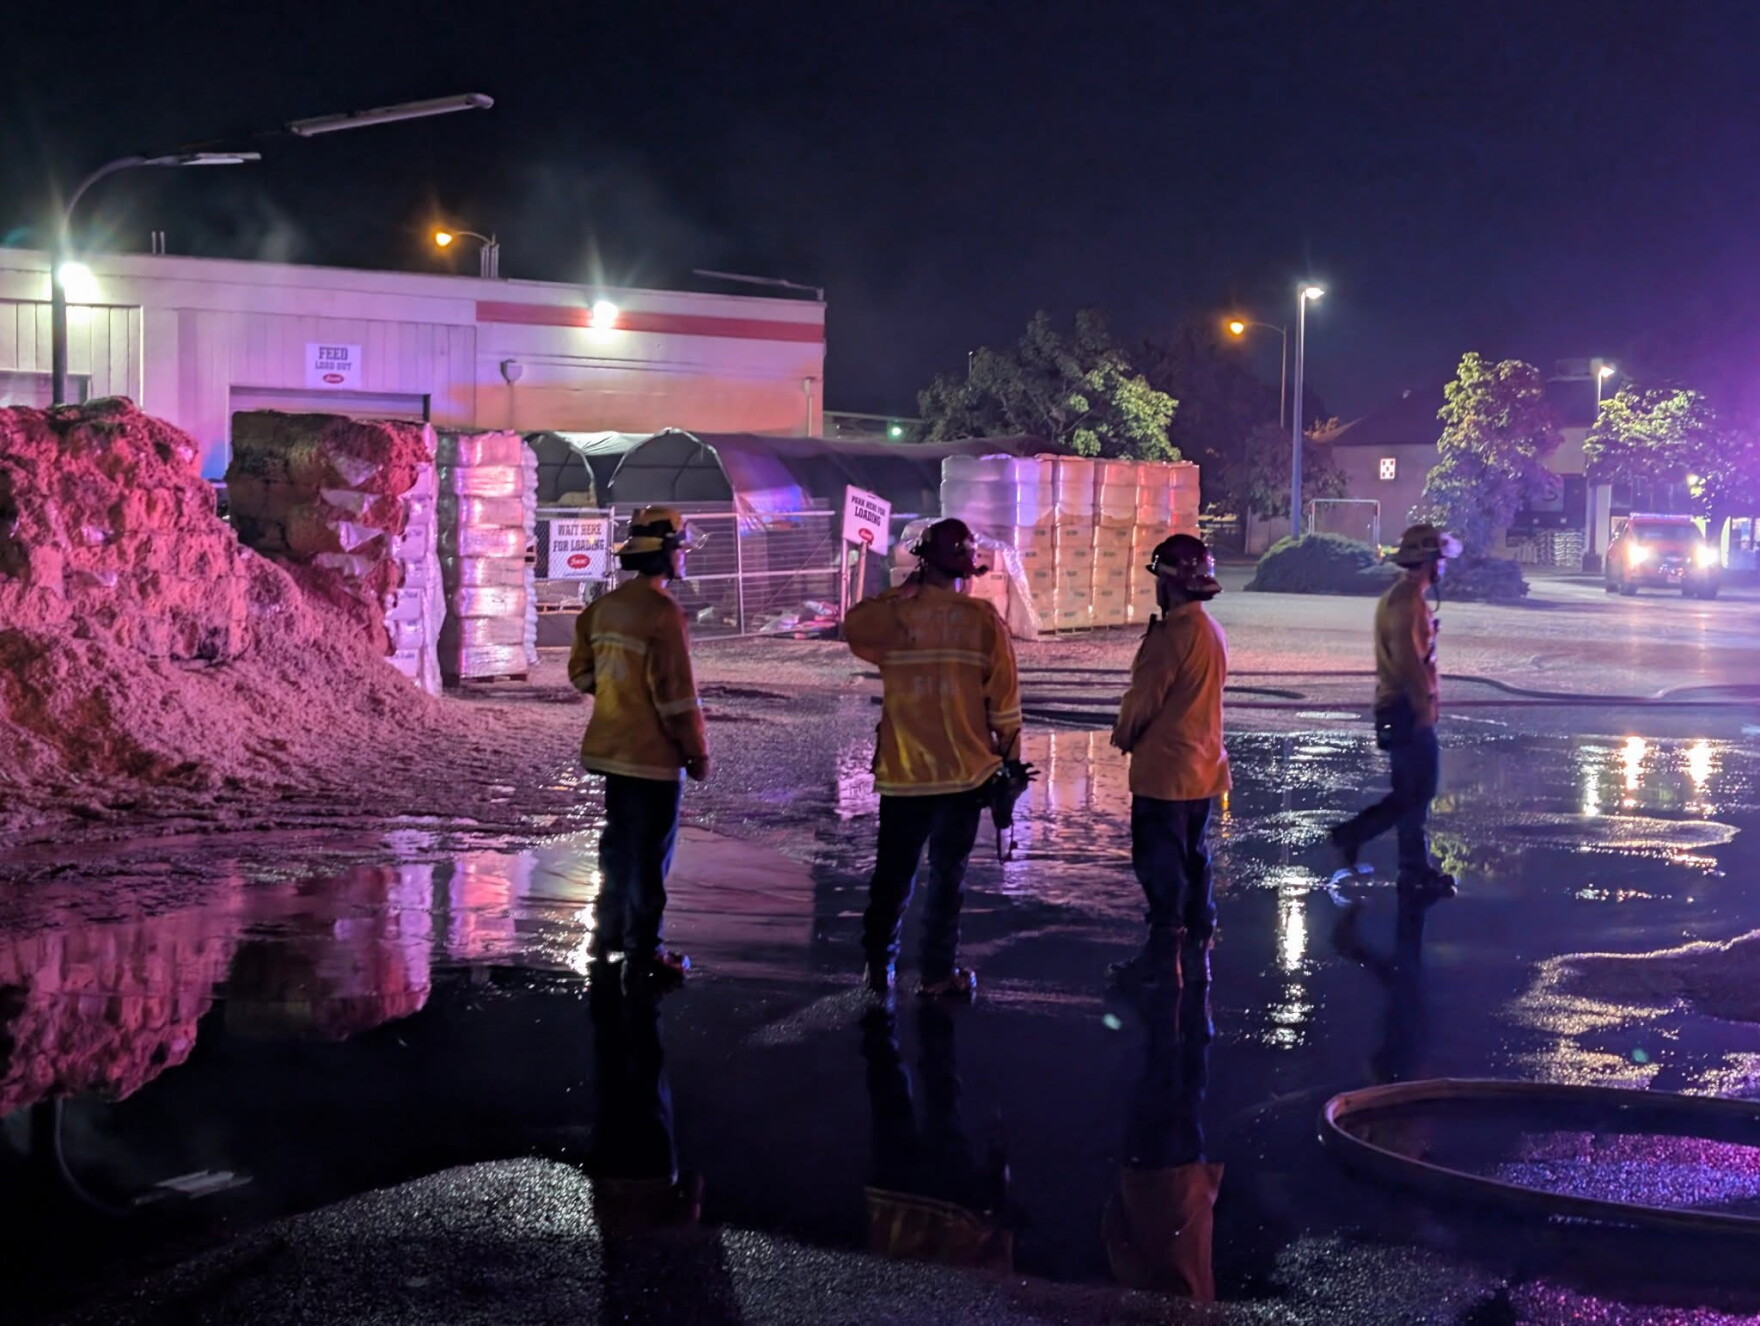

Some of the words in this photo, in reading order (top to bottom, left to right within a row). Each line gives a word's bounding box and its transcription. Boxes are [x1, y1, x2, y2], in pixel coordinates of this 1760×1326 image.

[318, 346, 348, 360] FEED
[854, 505, 881, 526] LOADING
[558, 524, 578, 536] WAIT
[580, 524, 602, 536] HERE
[553, 540, 569, 552] FOR
[570, 539, 605, 551] LOADING
